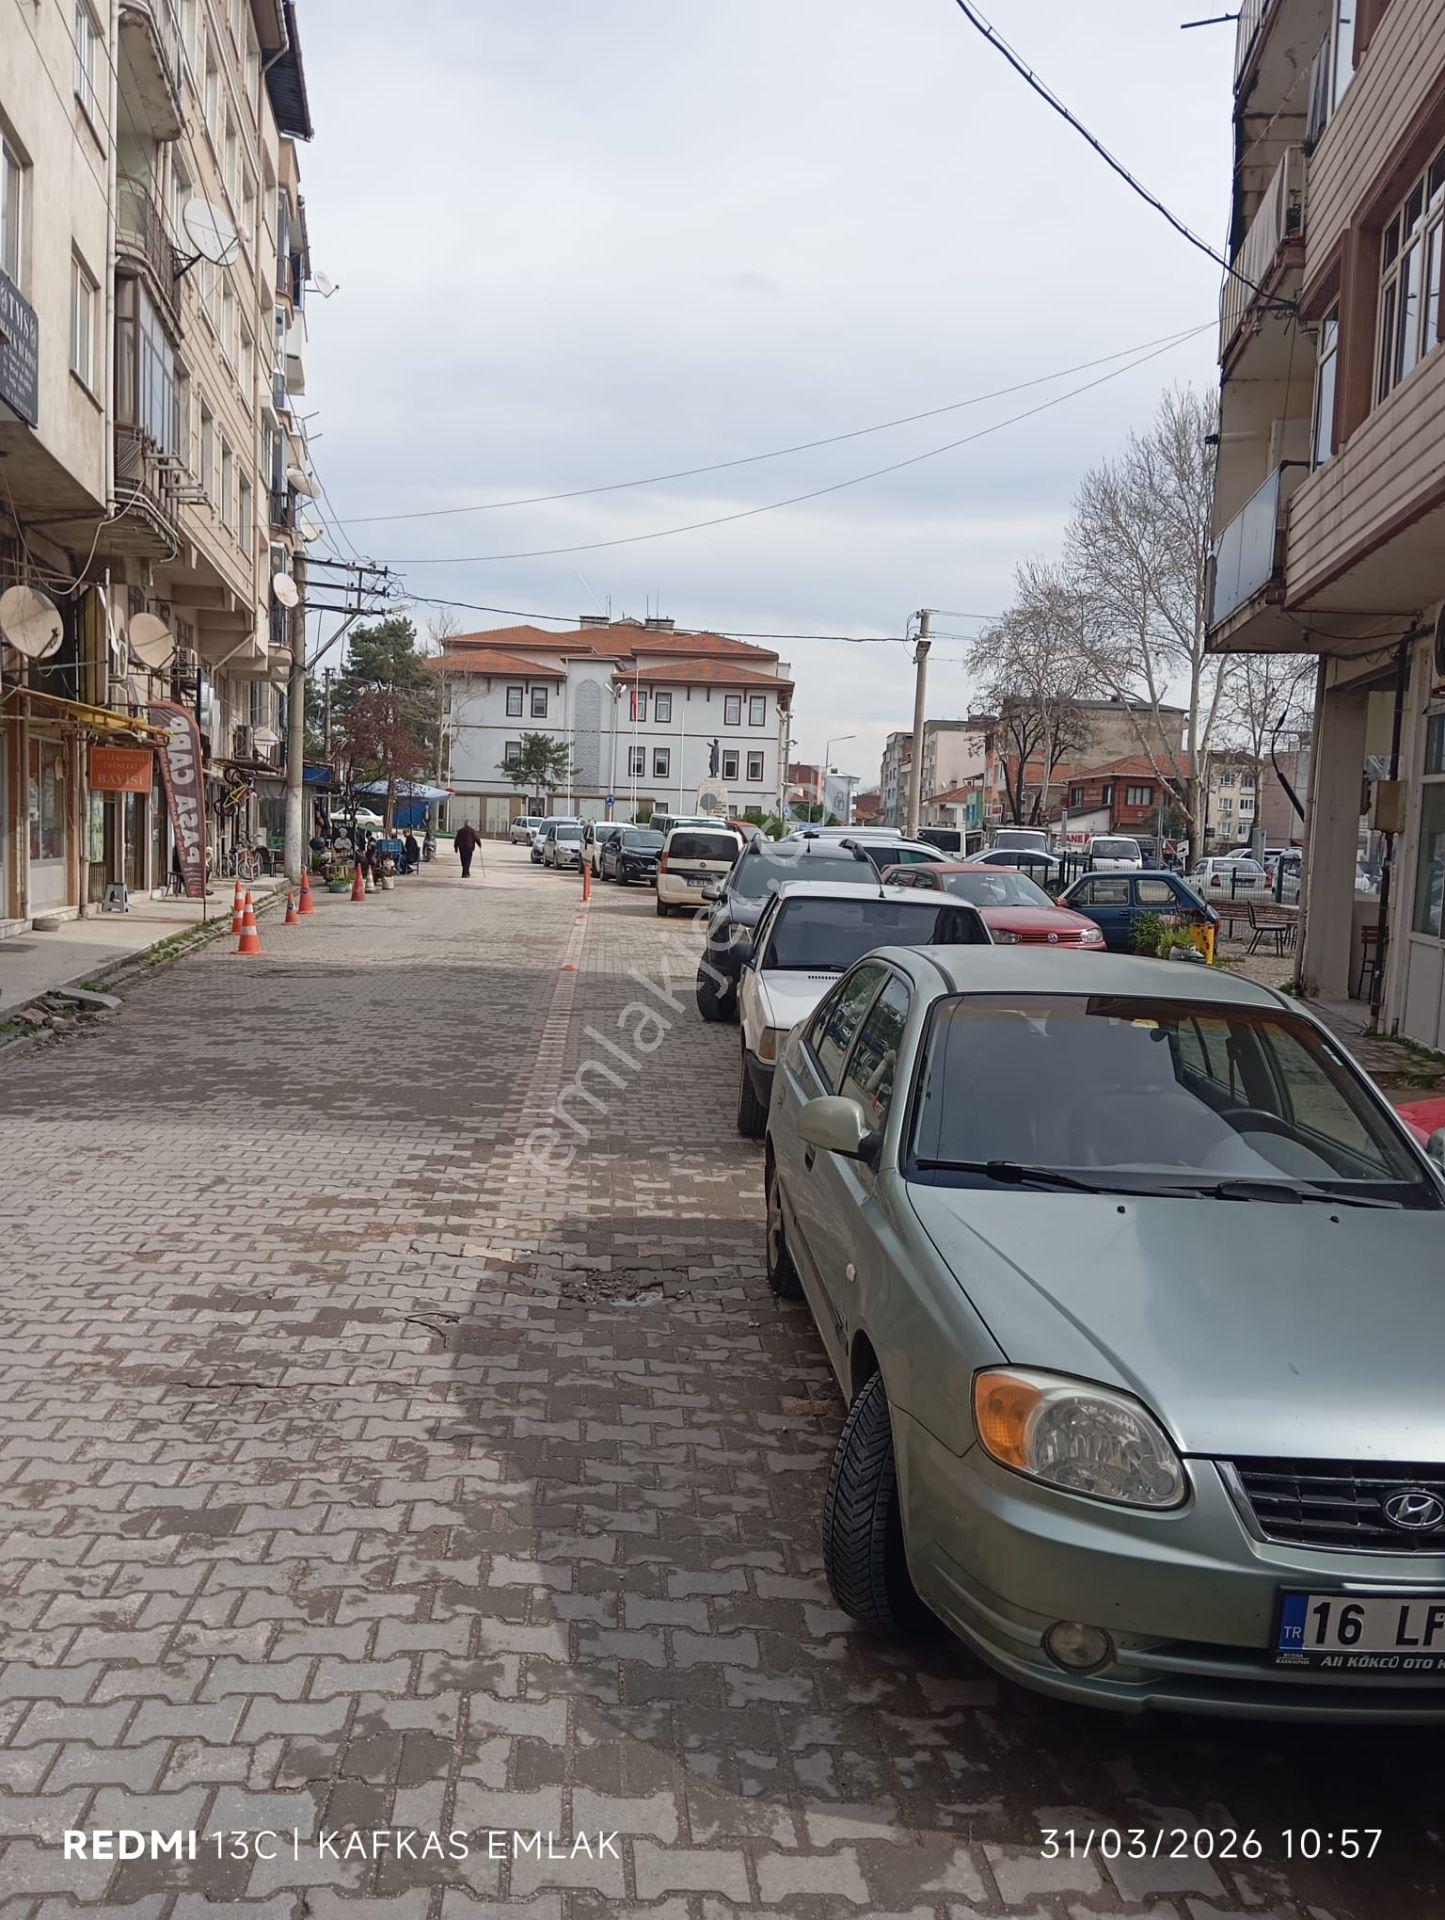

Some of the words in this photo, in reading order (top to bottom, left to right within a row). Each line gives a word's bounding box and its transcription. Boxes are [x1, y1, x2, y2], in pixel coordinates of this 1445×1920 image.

[1313, 1601, 1365, 1646] 16
[1395, 1605, 1445, 1647] LF
[1284, 1626, 1302, 1639] TR
[1403, 1658, 1434, 1669] OTO
